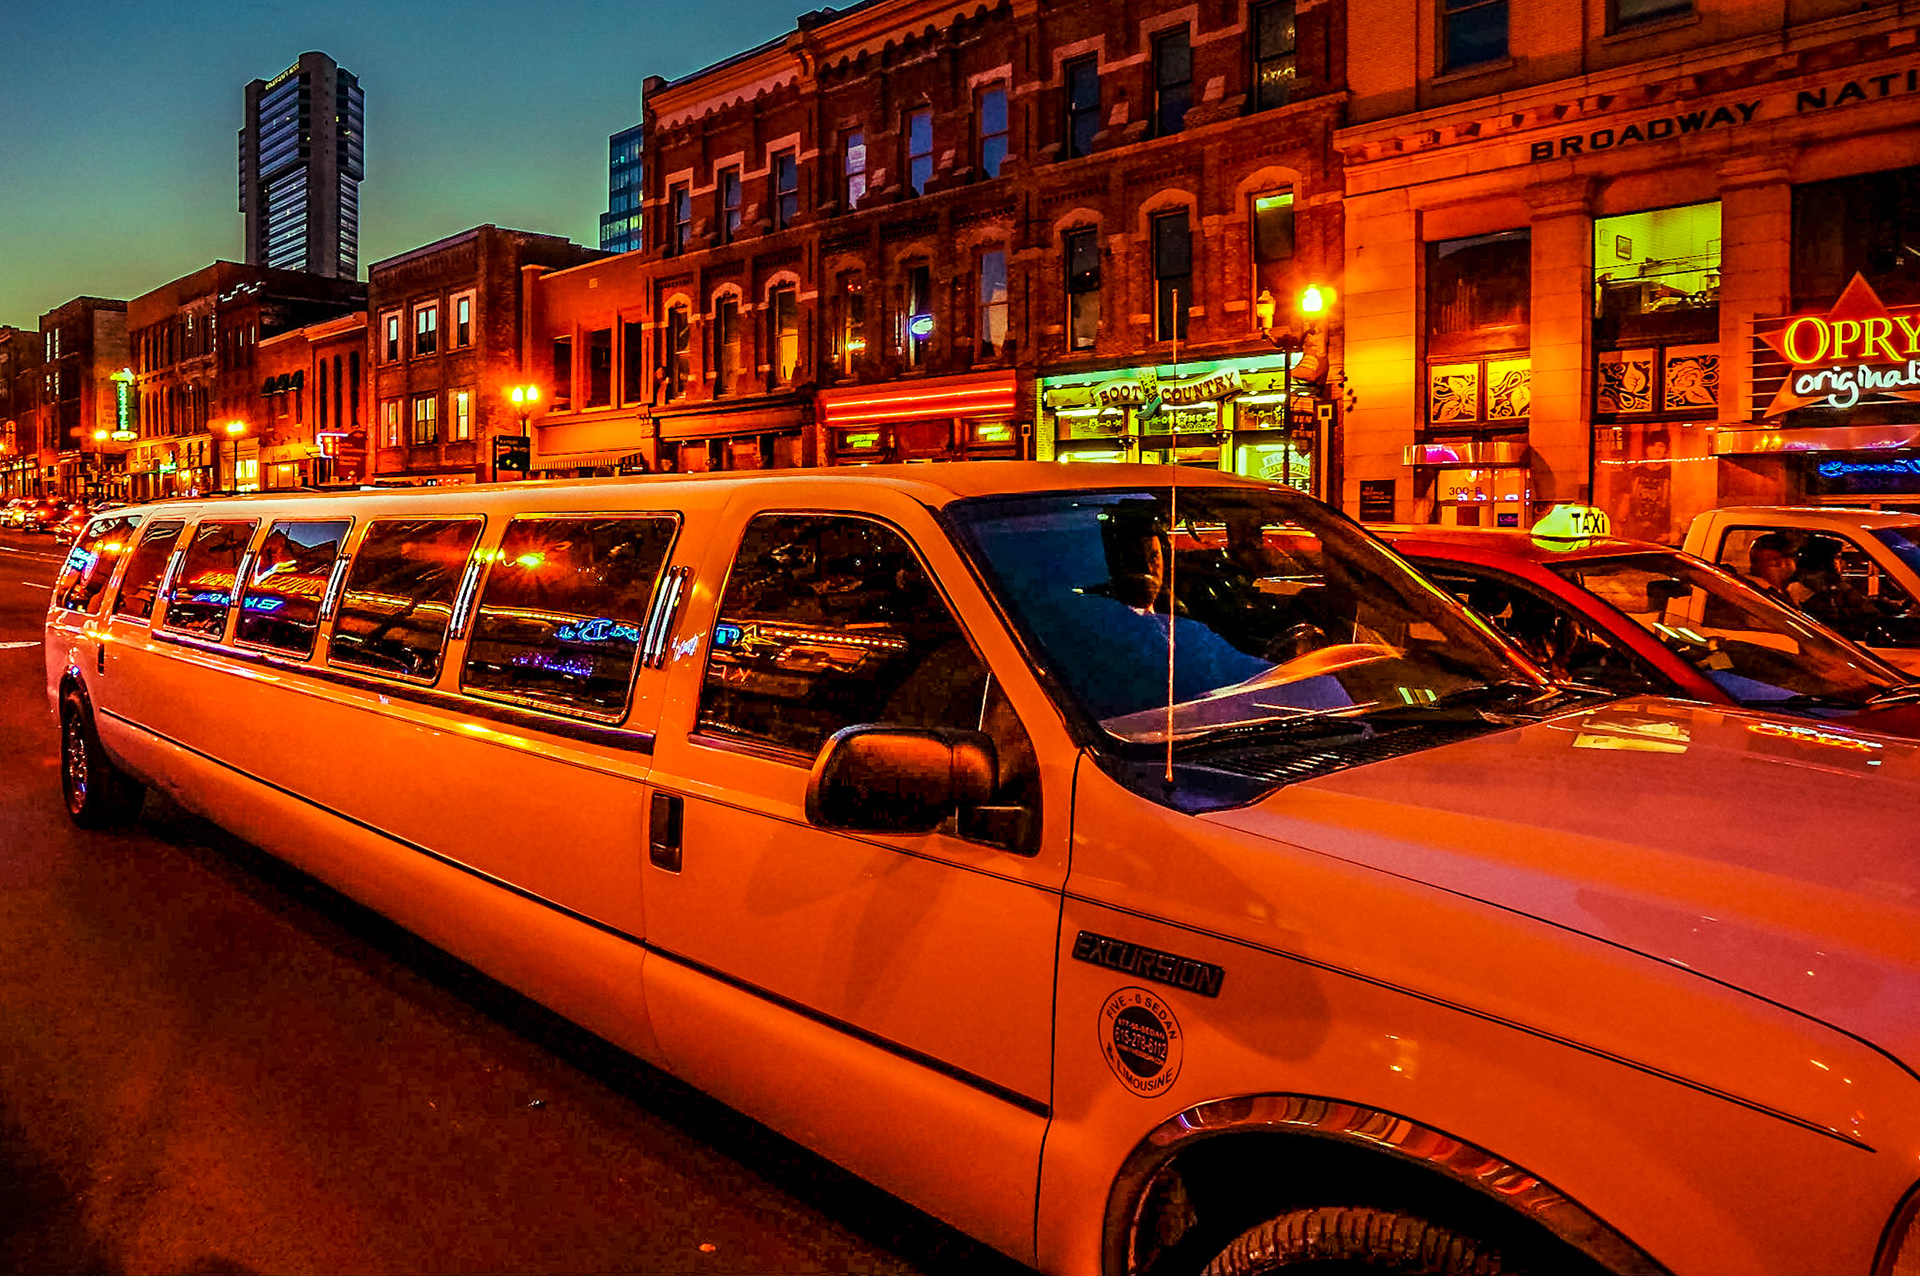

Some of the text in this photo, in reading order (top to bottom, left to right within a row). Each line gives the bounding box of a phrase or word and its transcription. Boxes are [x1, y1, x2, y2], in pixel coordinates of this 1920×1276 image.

[1531, 71, 1917, 162] BROADWAY NATI
[1784, 316, 1920, 364] OPRY
[1100, 372, 1234, 406] BOOT COUNTRY
[1075, 933, 1222, 994] EXCURSION
[1106, 996, 1127, 1020] FIVE
[1144, 997, 1178, 1040] SEDAN
[1114, 1027, 1167, 1059] 615-278-6112
[1117, 1059, 1174, 1091] LIMOUSINE
